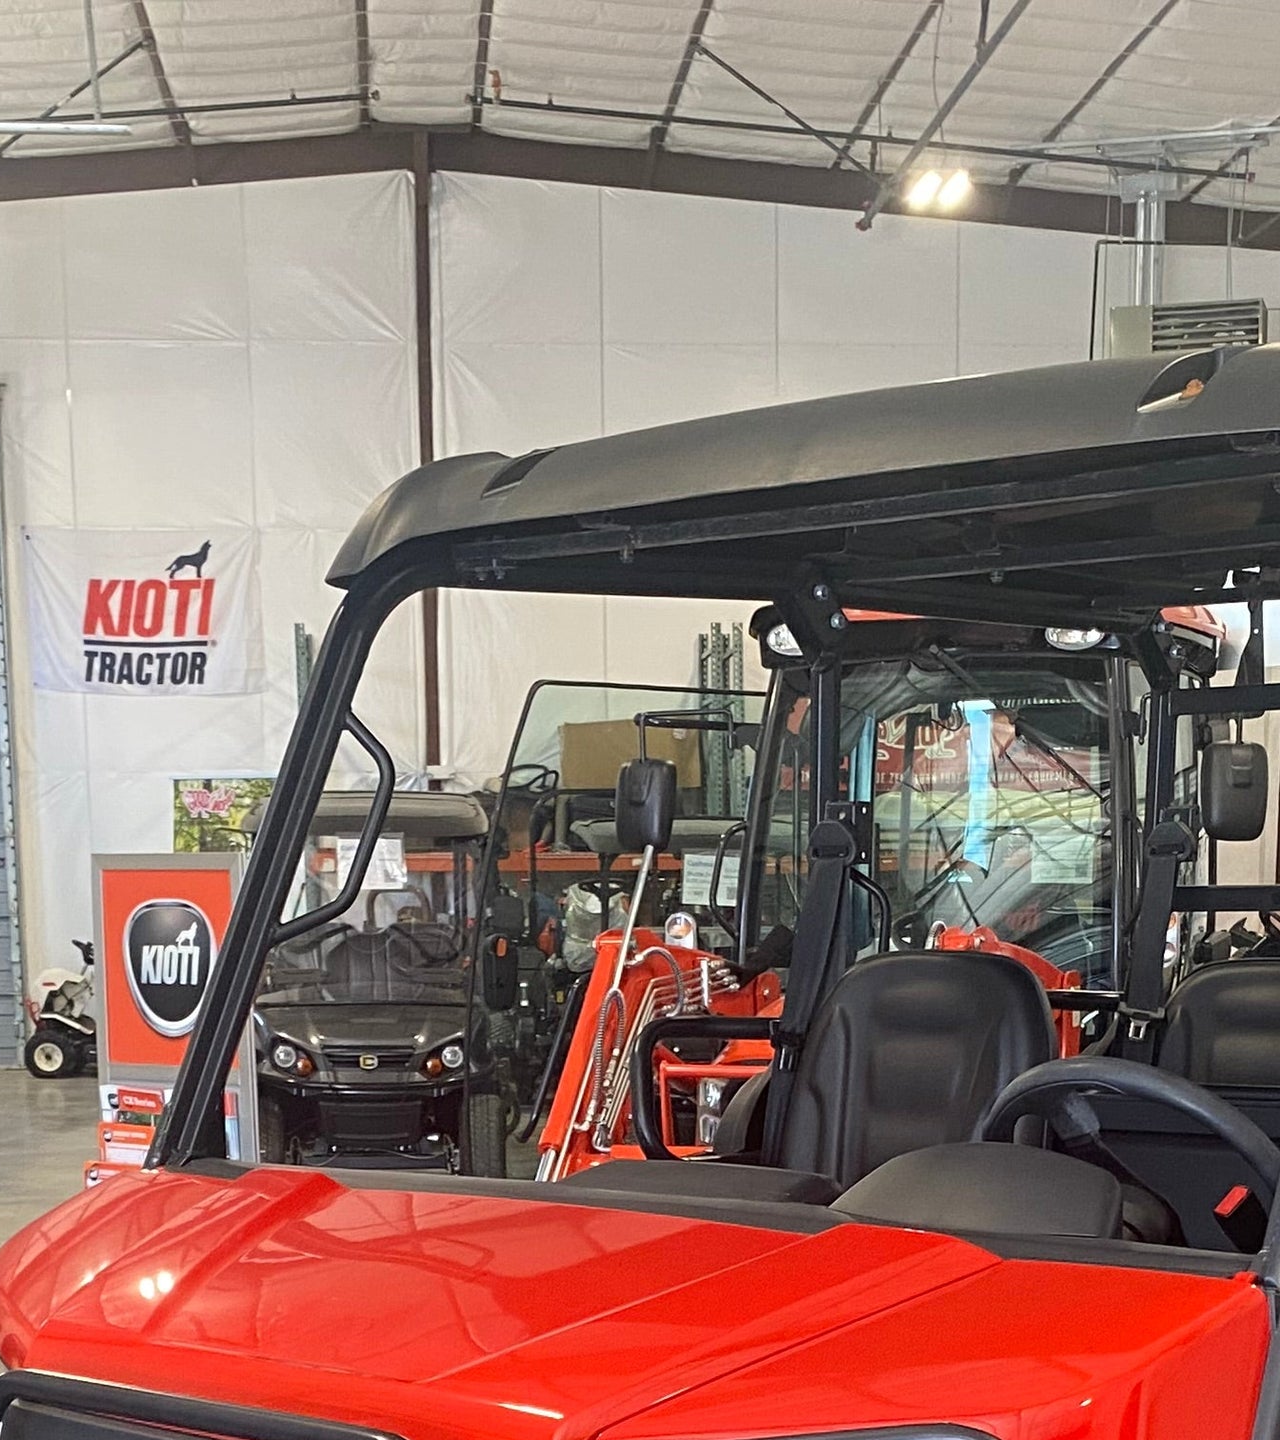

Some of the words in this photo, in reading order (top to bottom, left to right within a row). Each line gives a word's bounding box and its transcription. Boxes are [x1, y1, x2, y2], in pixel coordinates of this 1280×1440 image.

[82, 578, 215, 638] KIOTI
[84, 650, 207, 686] TRACTOR
[140, 945, 200, 986] KIOTI
